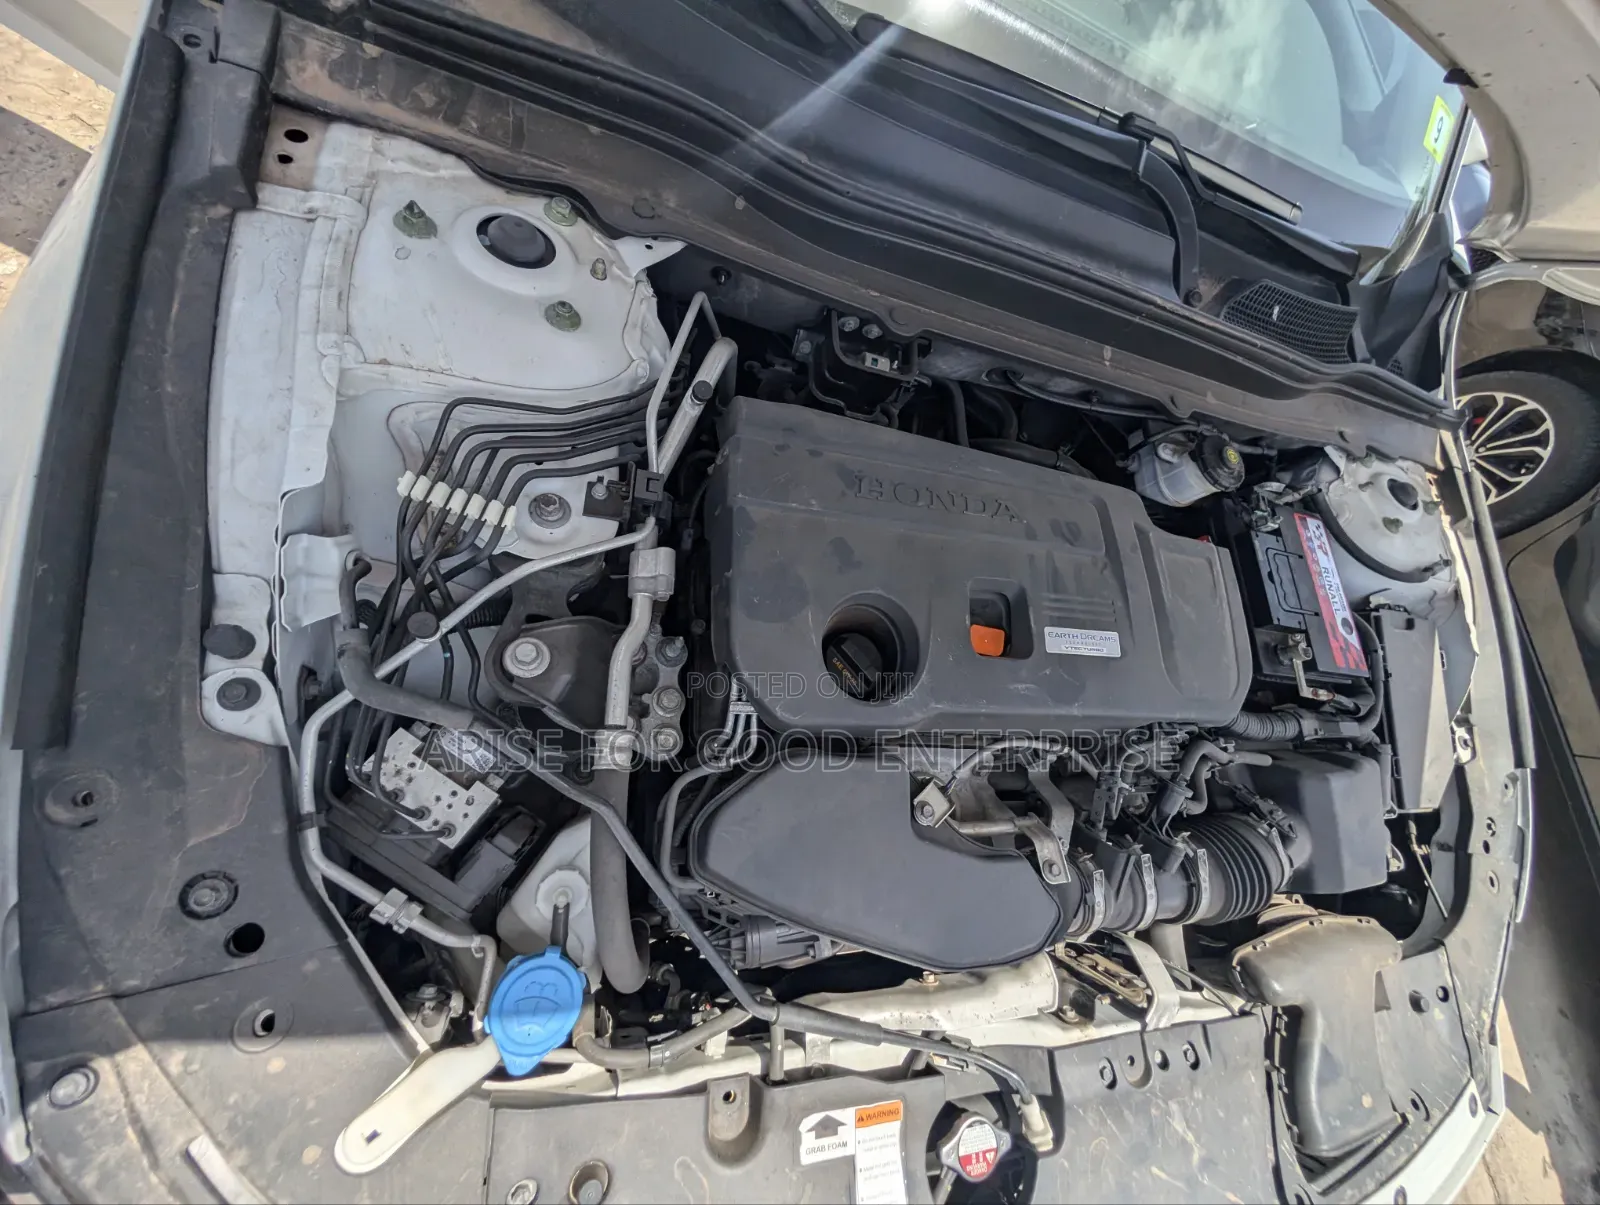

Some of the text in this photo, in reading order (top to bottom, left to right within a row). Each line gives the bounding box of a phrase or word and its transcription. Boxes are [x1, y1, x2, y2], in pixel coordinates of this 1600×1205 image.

[854, 474, 1027, 524] HONDA
[1322, 566, 1341, 615] RUNALL
[1048, 631, 1079, 640] EARTH
[866, 1108, 900, 1121] WARNING
[805, 1144, 826, 1156] GRAB
[828, 1140, 848, 1152] FOAM
